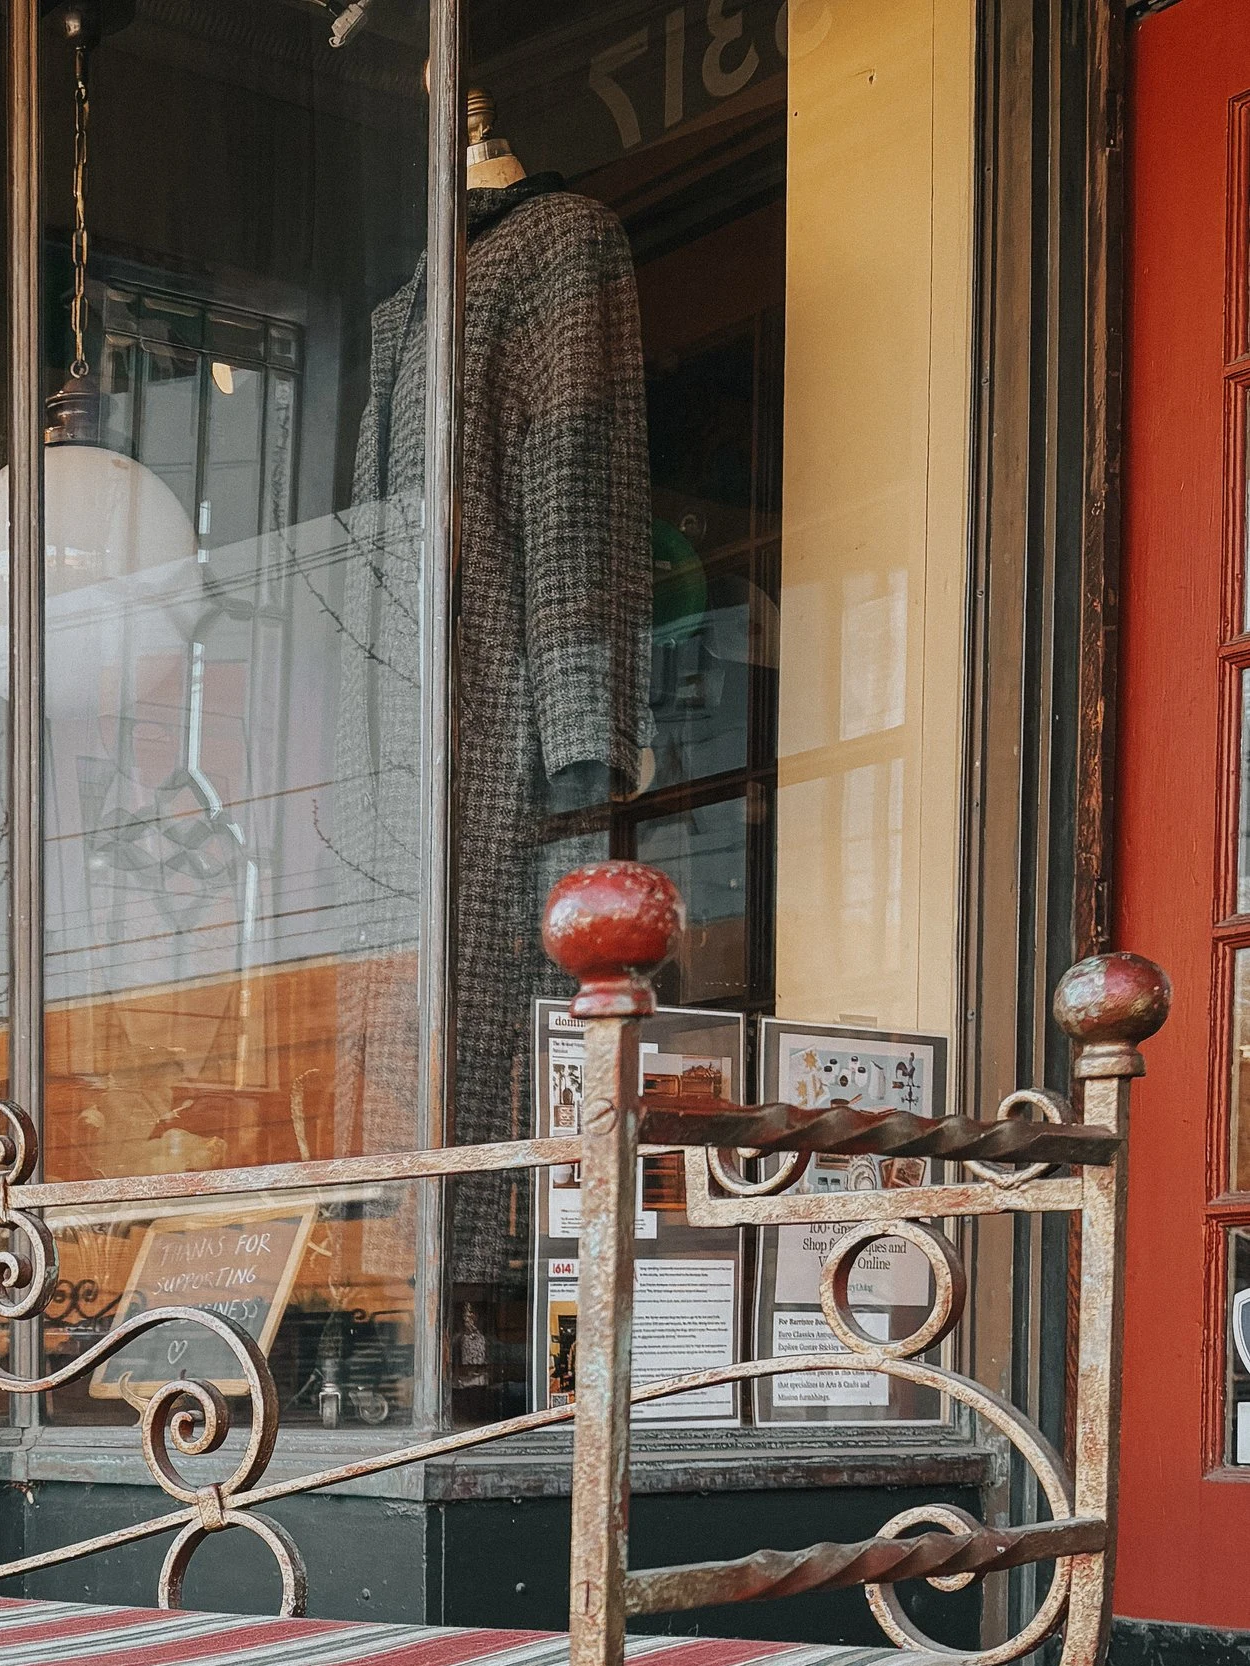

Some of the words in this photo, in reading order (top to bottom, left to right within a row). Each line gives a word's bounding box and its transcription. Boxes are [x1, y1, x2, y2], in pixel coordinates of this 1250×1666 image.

[161, 1235, 227, 1266] THANKS
[234, 1232, 271, 1256] FOR
[802, 1238, 828, 1254] Shop
[888, 1240, 907, 1254] and
[857, 1256, 892, 1270] Online
[152, 1265, 256, 1295] SUPPORTING
